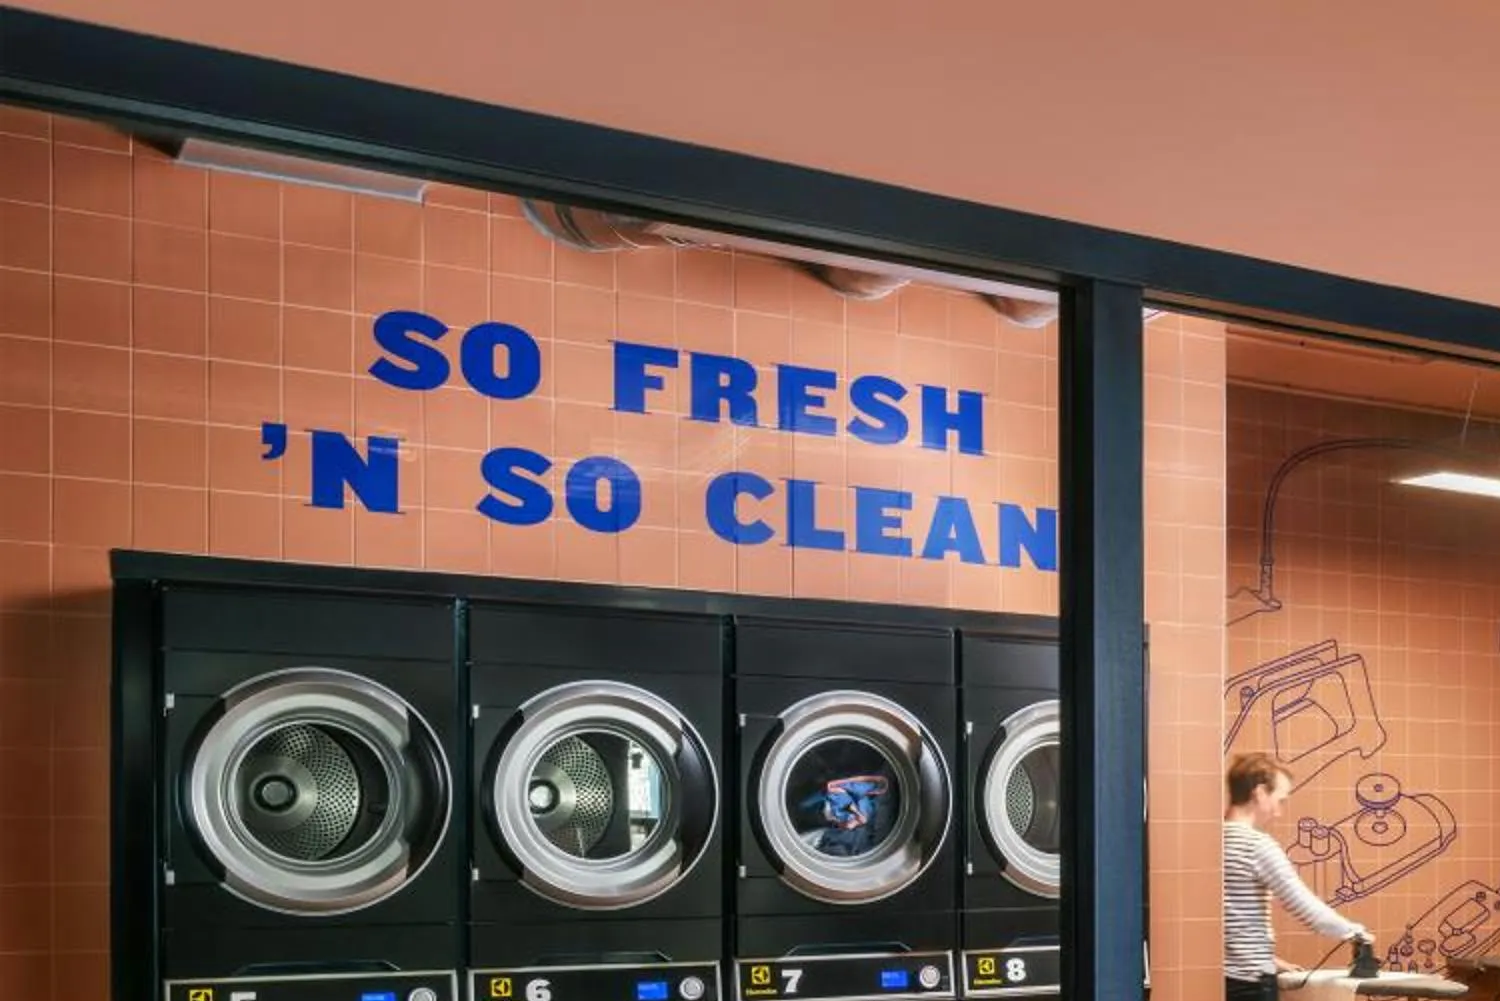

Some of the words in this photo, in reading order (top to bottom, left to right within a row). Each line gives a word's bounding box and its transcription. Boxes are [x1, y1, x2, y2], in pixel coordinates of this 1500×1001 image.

[368, 310, 542, 400] SO
[608, 339, 987, 457] FRESH
[476, 446, 642, 535] SO
[704, 470, 1059, 573] CLEAN
[781, 968, 803, 994] 7
[1006, 957, 1027, 982] 8
